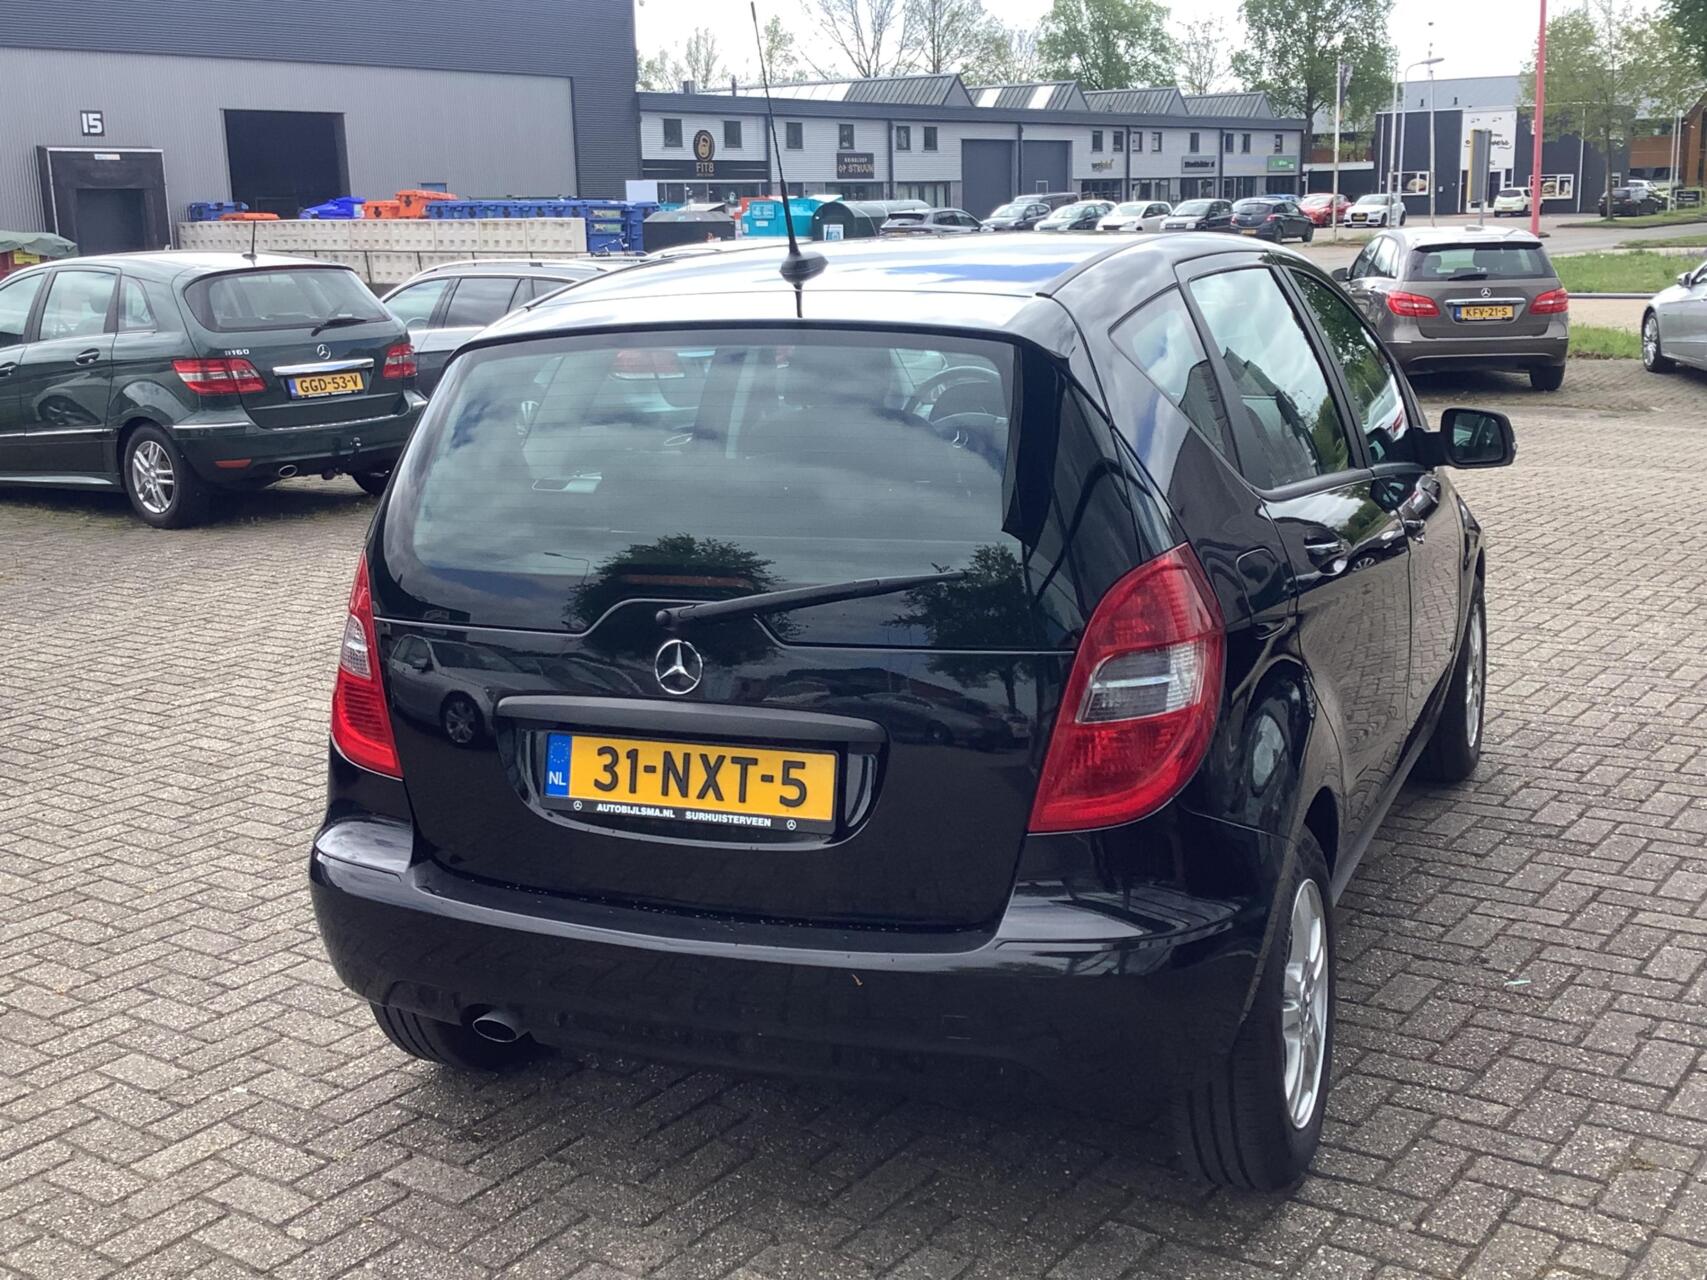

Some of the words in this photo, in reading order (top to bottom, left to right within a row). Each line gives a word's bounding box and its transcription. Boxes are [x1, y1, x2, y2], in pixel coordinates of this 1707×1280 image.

[81, 112, 103, 134] 15
[300, 374, 359, 394] GGD-53-V
[548, 770, 567, 786] NL
[593, 745, 808, 809] 31-NXT-5
[596, 803, 676, 818] AUTOBIJLSMA.NL
[685, 811, 772, 827] SURHUISTERVEEN
